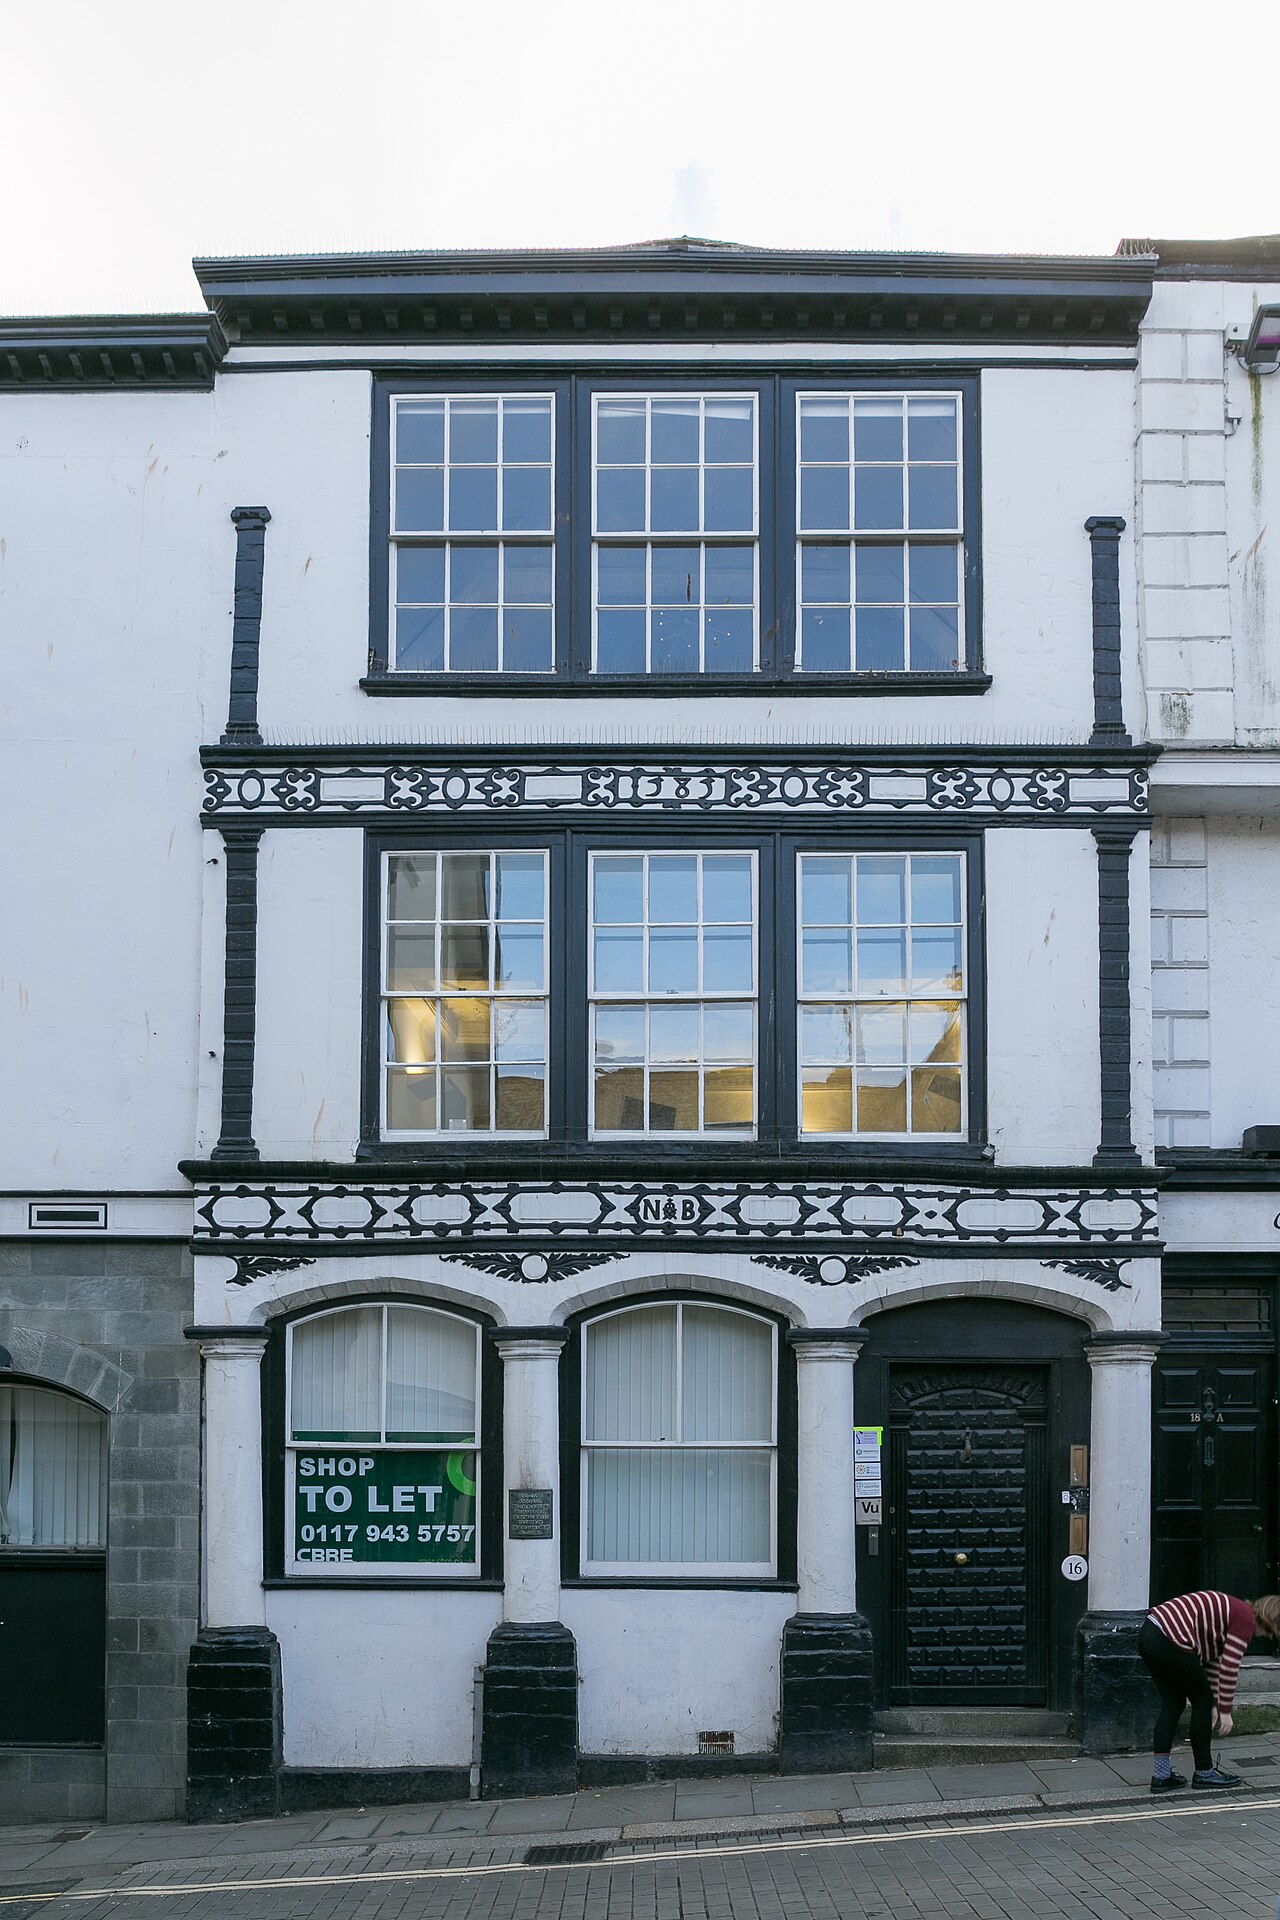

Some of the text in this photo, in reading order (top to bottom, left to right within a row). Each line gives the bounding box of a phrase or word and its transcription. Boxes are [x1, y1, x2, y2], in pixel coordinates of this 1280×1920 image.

[643, 1199, 695, 1220] N B
[1190, 1413, 1224, 1422] 18 A
[299, 1457, 375, 1476] SHOP
[299, 1485, 442, 1513] TO LET
[861, 1501, 879, 1514] Vu
[301, 1524, 475, 1542] 0117 943 5757
[296, 1548, 353, 1562] CBRE
[1068, 1562, 1083, 1575] 16
